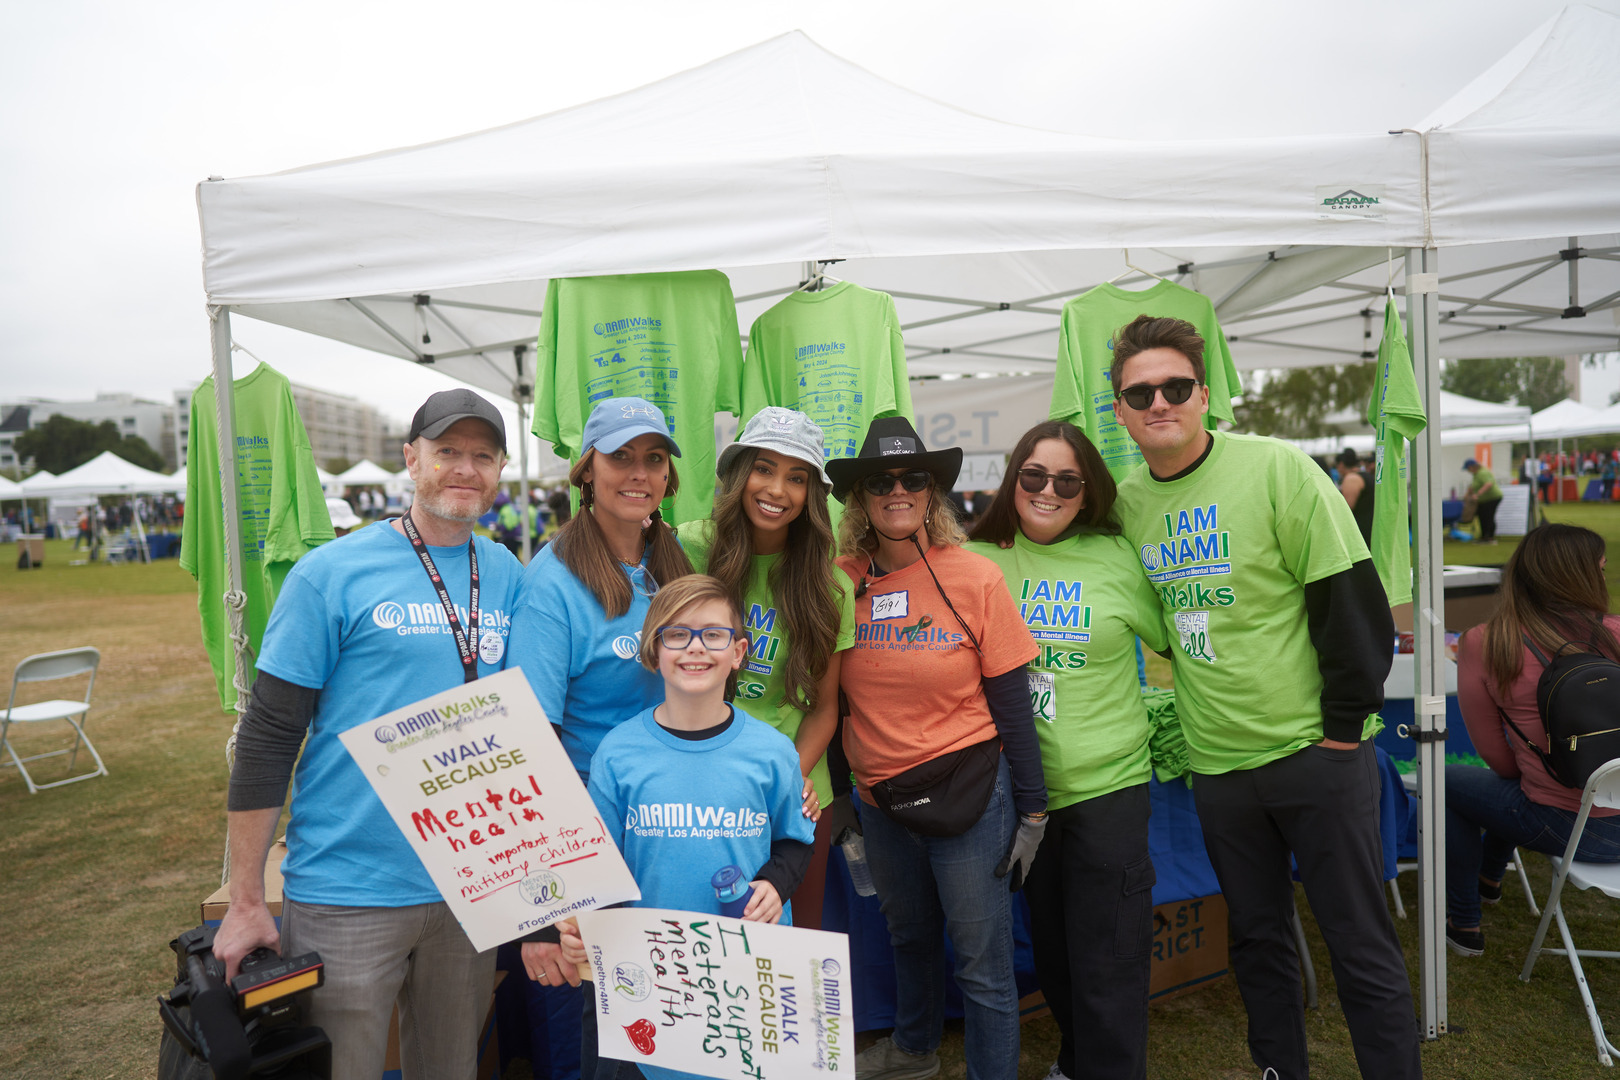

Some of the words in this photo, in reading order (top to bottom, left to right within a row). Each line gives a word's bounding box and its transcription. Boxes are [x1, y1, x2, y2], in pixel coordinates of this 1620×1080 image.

[1324, 197, 1379, 206] CARAVAN
[605, 317, 662, 333] NAMIWalks
[1164, 512, 1174, 539] I
[1175, 503, 1218, 537] AM
[1159, 531, 1230, 568] NAMI
[420, 551, 438, 576] SPARTAN
[1191, 567, 1209, 576] Mental
[1209, 565, 1230, 573] Illness
[439, 589, 455, 616] SPARTAN
[1020, 578, 1030, 600] I
[1030, 579, 1083, 602] AM
[397, 624, 439, 637] Greater
[1176, 614, 1206, 624] MENTAL
[1177, 624, 1205, 634] HEALTH
[455, 630, 470, 657] SPARTAN
[869, 641, 885, 650] Los
[887, 642, 925, 652] Angeles
[927, 642, 961, 651] County
[1040, 631, 1064, 640] Mental
[1065, 633, 1088, 641] Illness
[1184, 631, 1213, 663] all
[1028, 674, 1051, 684] NTAL
[1028, 683, 1051, 692] ALTH
[395, 692, 501, 738] NAMIWalks
[422, 758, 433, 773] I
[433, 734, 503, 768] WALK
[419, 748, 527, 797] BECAUSE
[411, 775, 543, 842] Mental
[638, 802, 768, 828] NAMIWalks
[634, 826, 665, 838] Greater
[667, 827, 687, 838] Los
[690, 828, 734, 840] Angeles
[735, 827, 764, 839] County
[454, 866, 474, 879] is
[557, 826, 584, 844] for
[521, 872, 554, 888] MENTAL
[533, 881, 564, 906] all
[517, 896, 597, 931] #Together4MH
[717, 921, 751, 957] I
[592, 944, 609, 1015] #Together4MH
[614, 967, 635, 996] all
[638, 968, 646, 999] MENTAL
[756, 957, 779, 1054] BECAUSE
[779, 986, 799, 1044] WALK
[822, 978, 841, 1072] NAMIWalks
